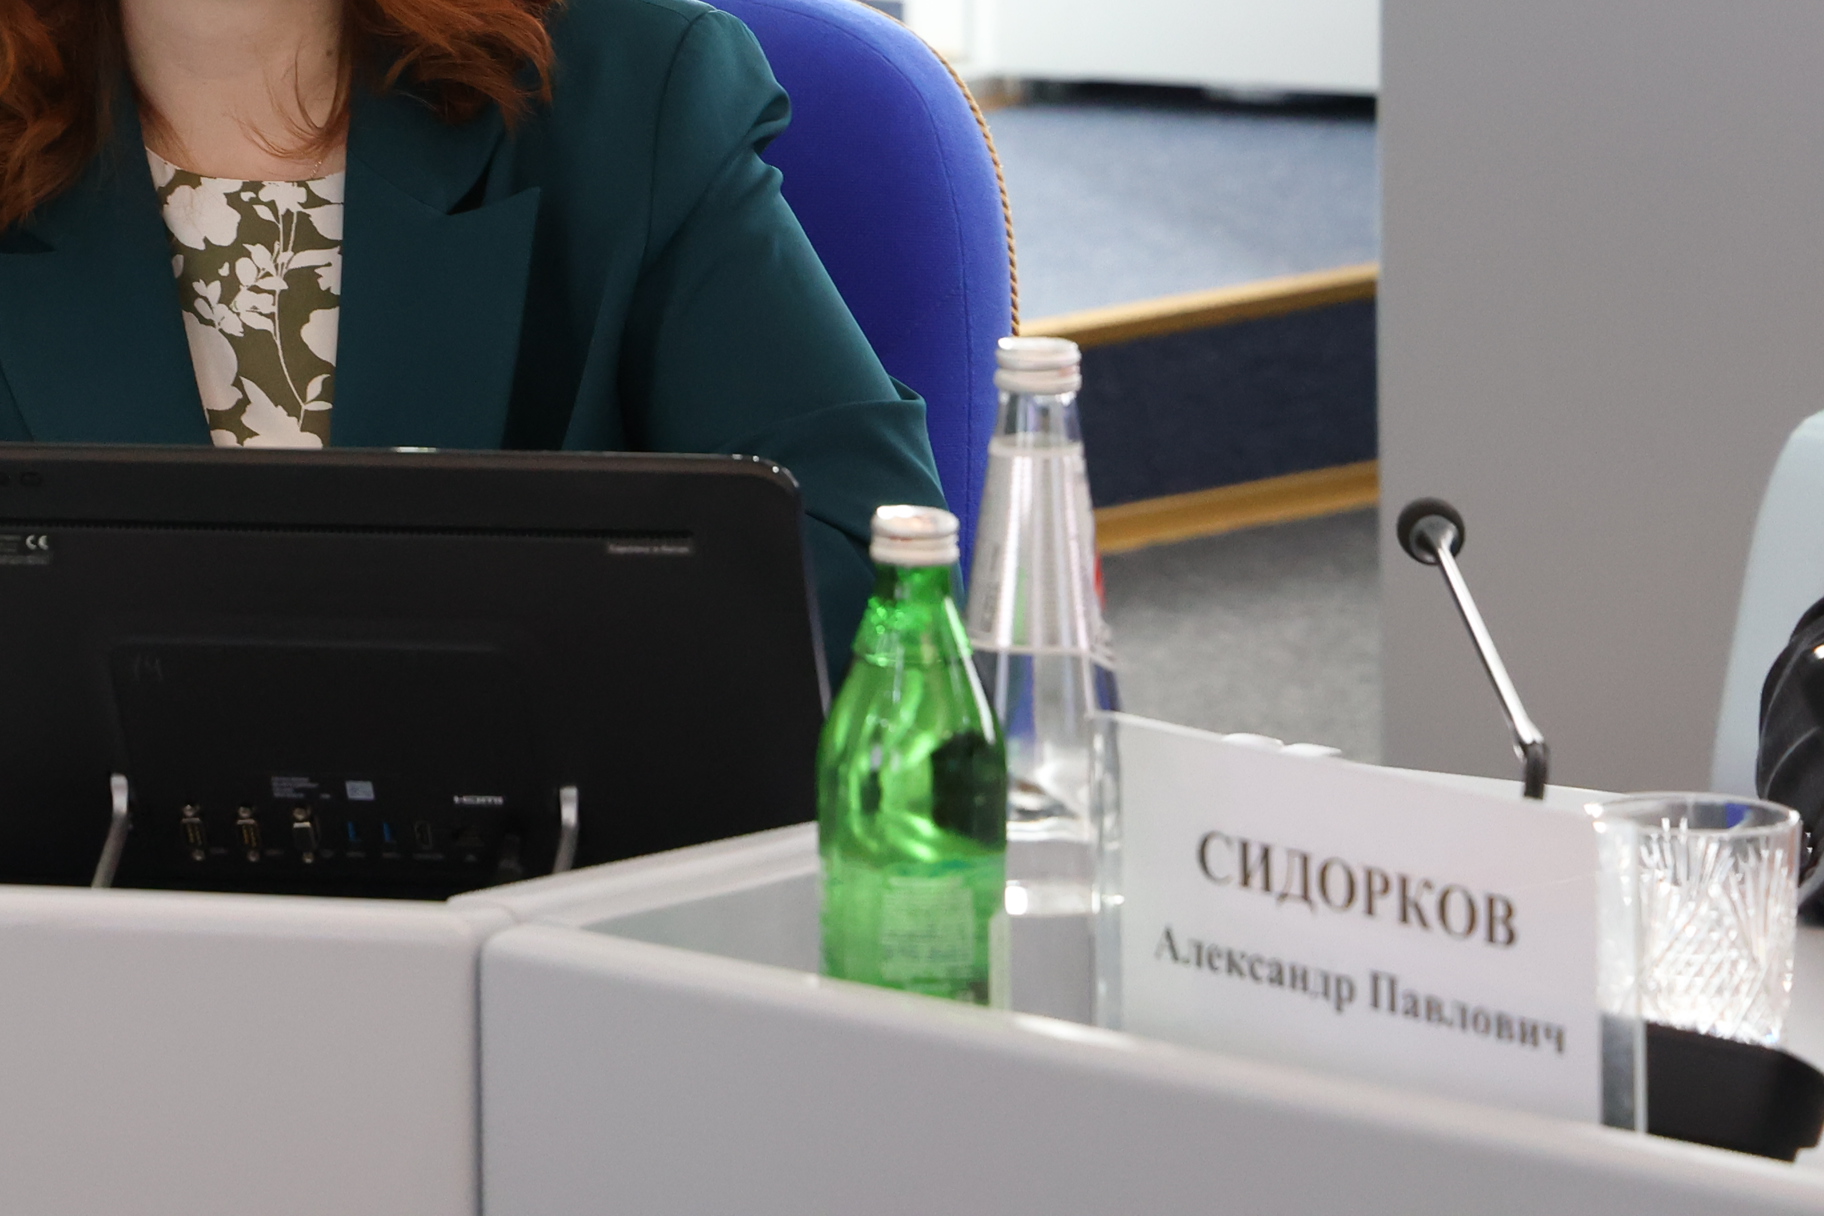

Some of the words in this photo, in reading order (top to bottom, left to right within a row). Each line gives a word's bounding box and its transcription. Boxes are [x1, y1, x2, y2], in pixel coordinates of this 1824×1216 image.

[1196, 830, 1518, 949] СИДОРКОВ
[1154, 926, 1357, 1015] Александр
[1368, 970, 1567, 1056] Павлович
